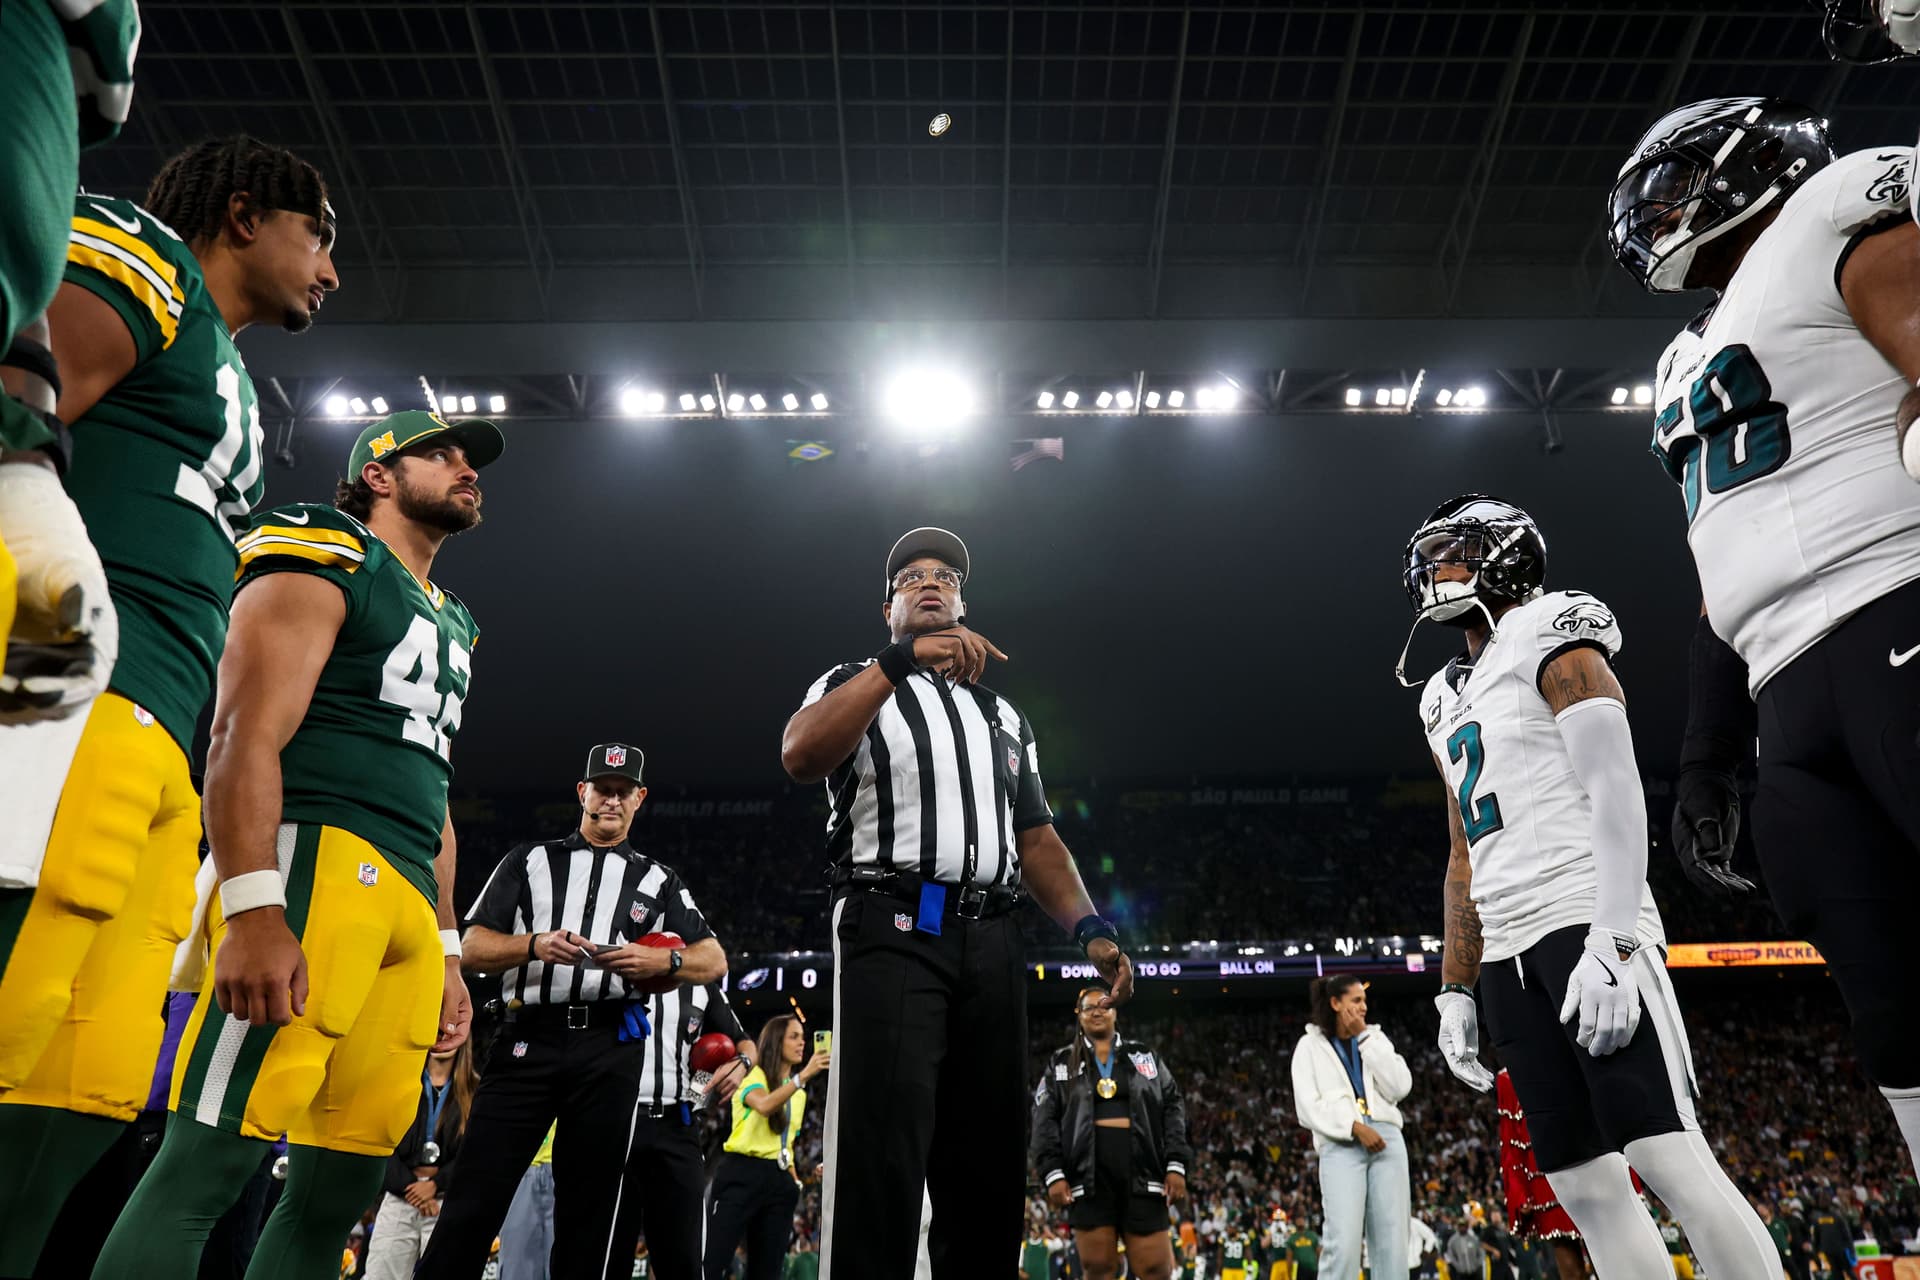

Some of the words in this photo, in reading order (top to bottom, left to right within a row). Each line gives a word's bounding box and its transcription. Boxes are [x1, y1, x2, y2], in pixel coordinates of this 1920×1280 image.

[368, 430, 398, 459] N
[379, 613, 472, 765] 42
[1446, 720, 1505, 849] 2
[1231, 789, 1289, 804] PAULO
[1297, 787, 1349, 802] GAME
[719, 800, 774, 816] GAME
[802, 968, 818, 989] 0
[1034, 964, 1045, 980] 1
[1138, 964, 1156, 976] TO
[1159, 963, 1181, 976] GO
[1220, 962, 1253, 975] BALL
[1257, 961, 1274, 974] ON
[632, 1258, 647, 1278] 21
[1860, 1265, 1879, 1280] G
